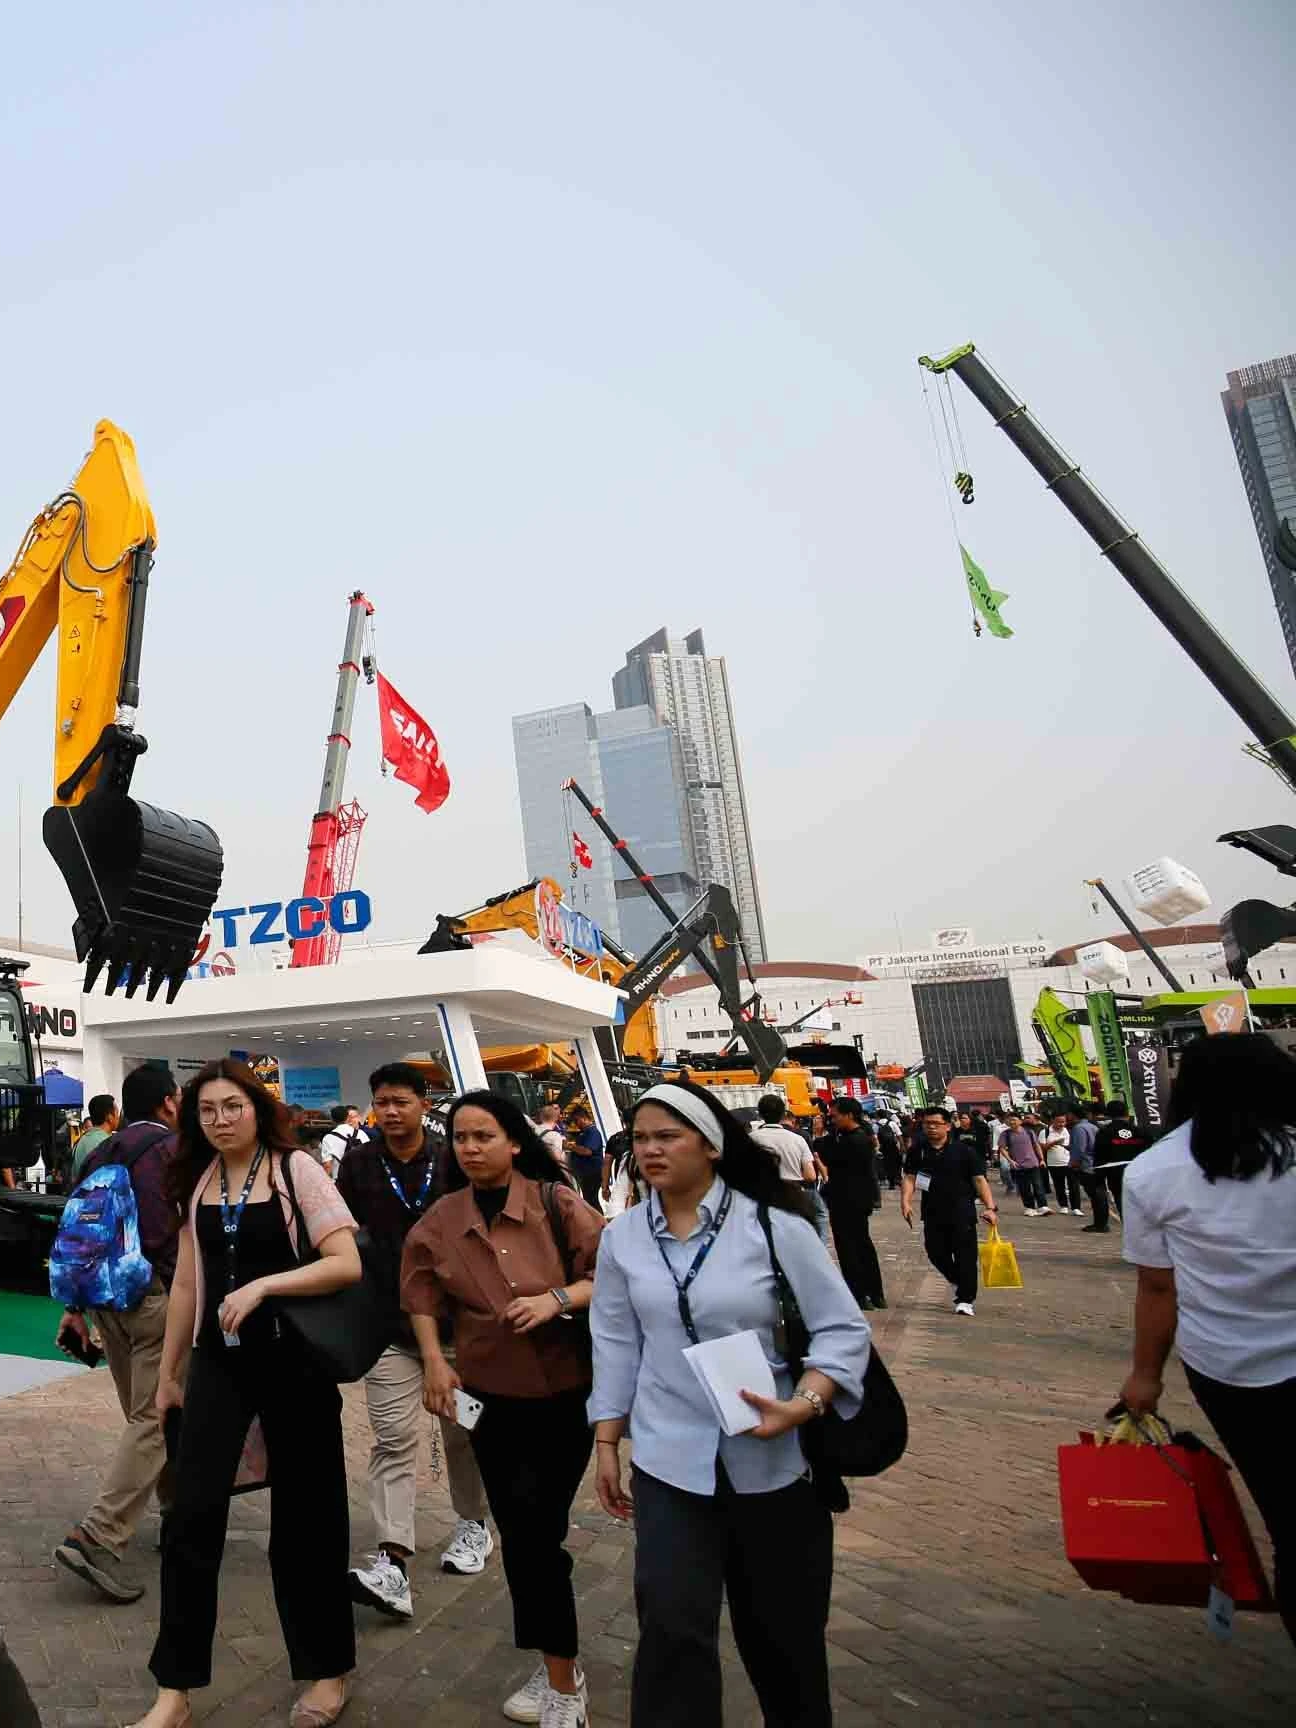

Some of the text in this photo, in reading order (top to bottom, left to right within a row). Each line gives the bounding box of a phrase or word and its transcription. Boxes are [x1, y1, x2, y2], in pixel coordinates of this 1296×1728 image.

[212, 889, 373, 948] TZCO
[868, 944, 1046, 967] PT Jakarta International Expo
[1099, 1013, 1125, 1094] ZOOMLION
